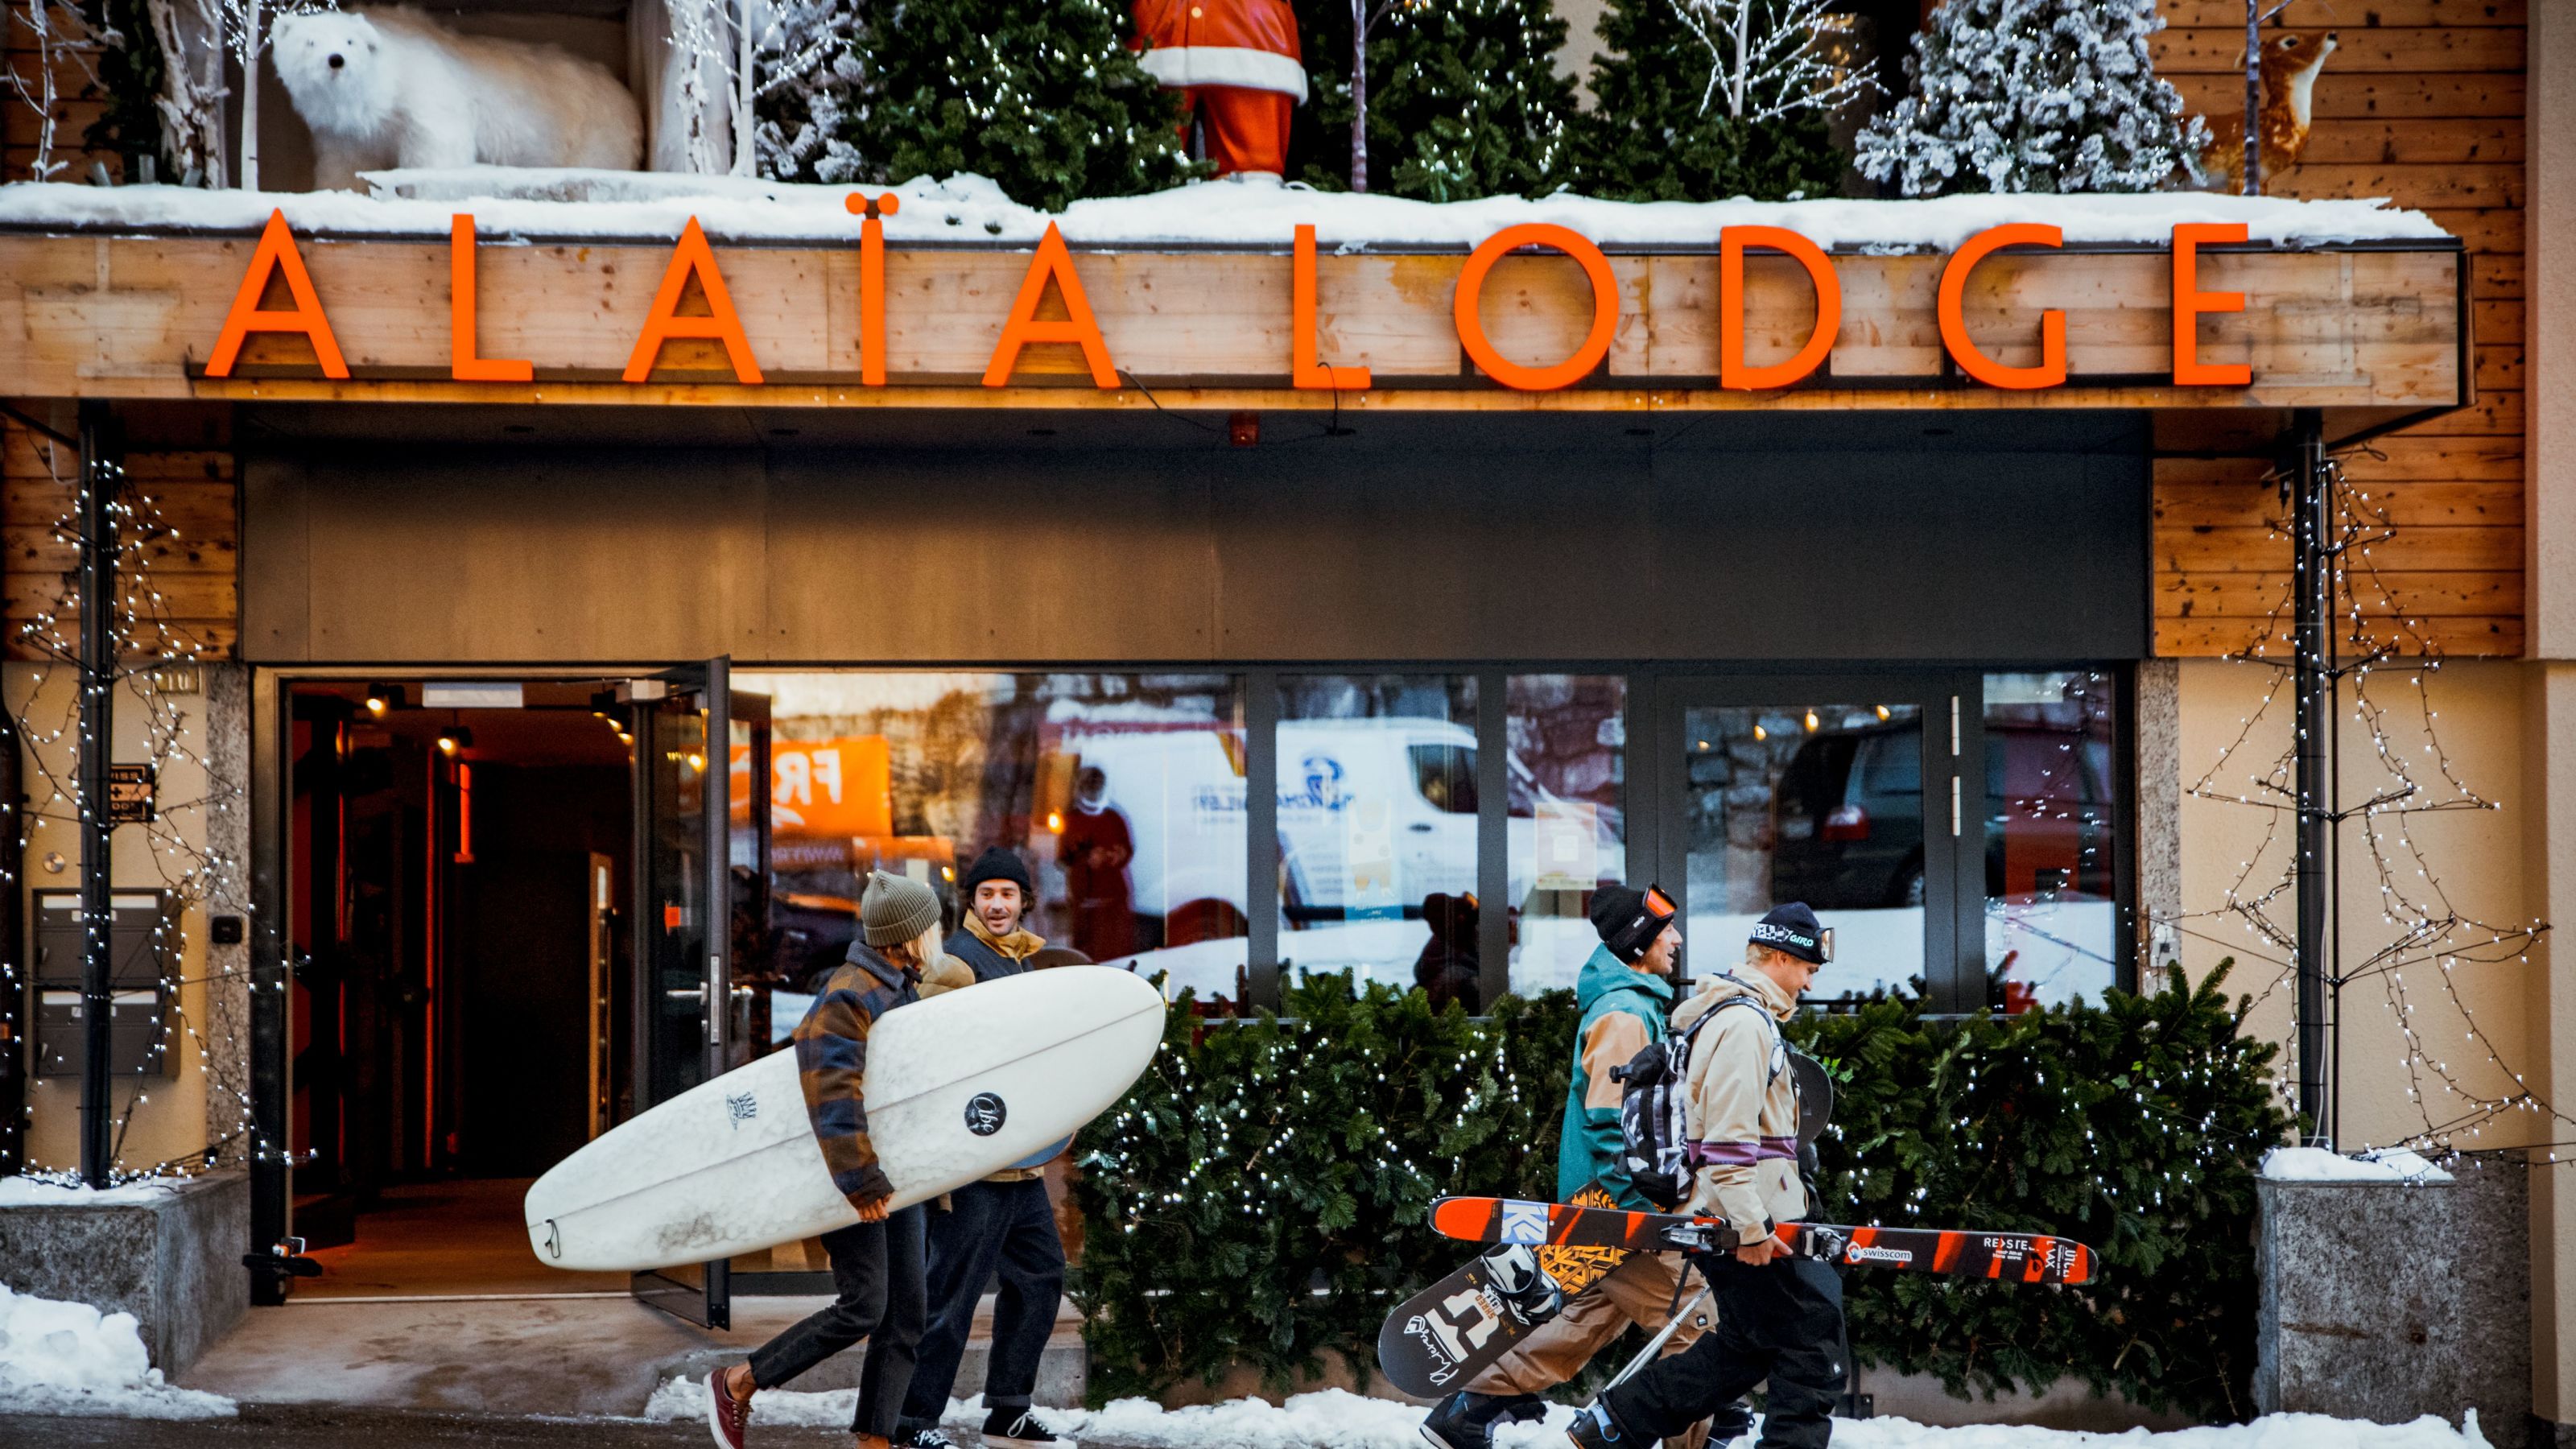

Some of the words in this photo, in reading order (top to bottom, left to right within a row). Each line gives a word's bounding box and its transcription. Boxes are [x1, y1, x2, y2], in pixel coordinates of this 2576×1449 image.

[204, 192, 1121, 388] ALAÏA
[1293, 222, 2252, 390] LODGE
[1789, 934, 1814, 947] GIRO
[1501, 1203, 1549, 1241] K2
[1863, 1248, 1911, 1260] swisscom
